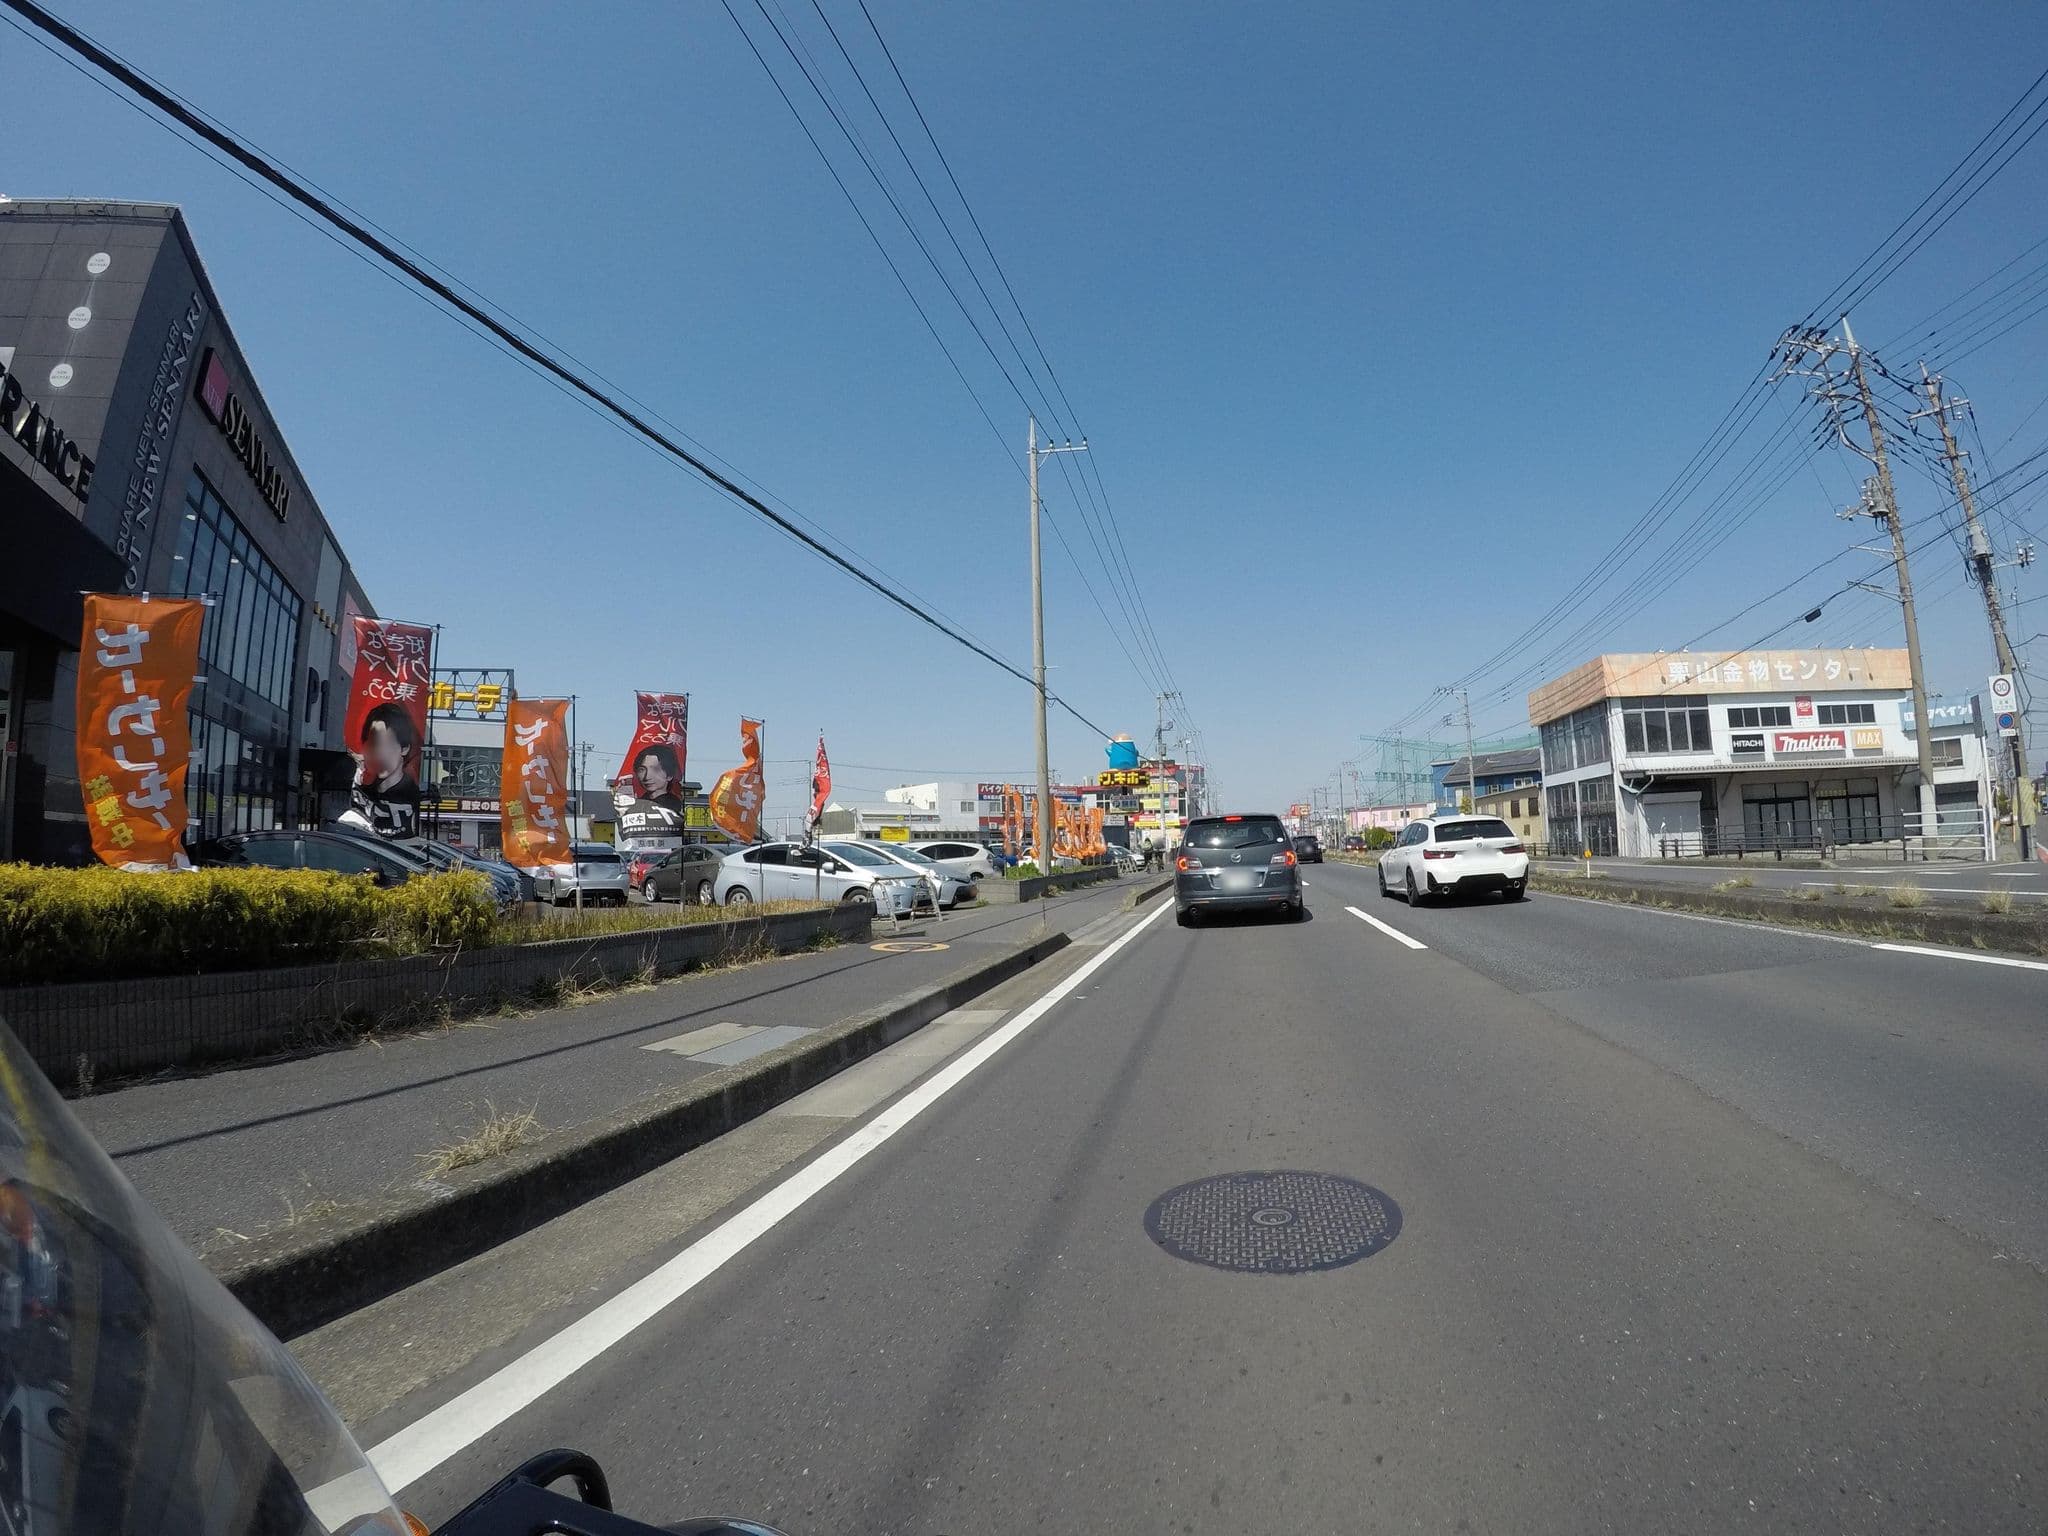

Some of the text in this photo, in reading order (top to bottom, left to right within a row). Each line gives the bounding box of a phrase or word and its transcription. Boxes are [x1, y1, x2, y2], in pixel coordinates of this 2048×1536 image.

[136, 414, 153, 469] NEW
[152, 320, 180, 412] SENNARI
[157, 292, 202, 439] SENNARI
[224, 392, 292, 524] SENNARI
[95, 624, 173, 830] カーセンサー
[1732, 739, 1764, 748] HITACHI
[1857, 731, 1881, 745] MAX
